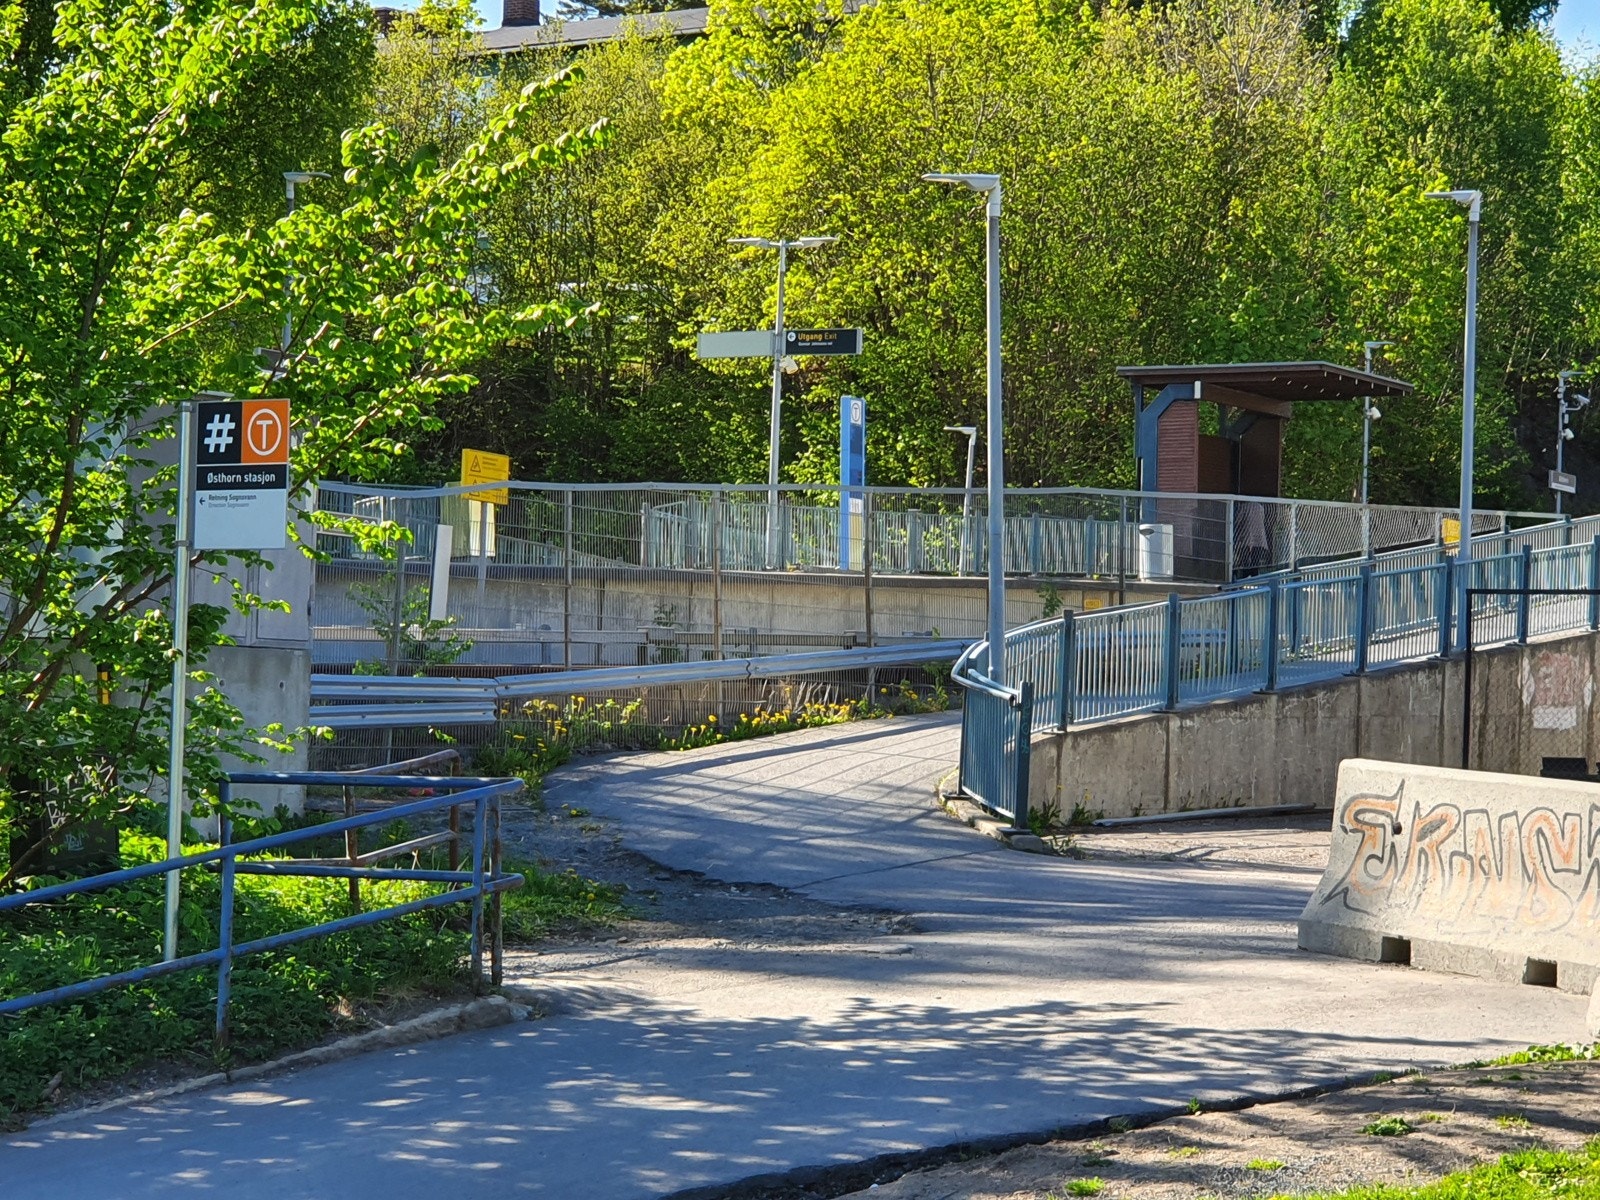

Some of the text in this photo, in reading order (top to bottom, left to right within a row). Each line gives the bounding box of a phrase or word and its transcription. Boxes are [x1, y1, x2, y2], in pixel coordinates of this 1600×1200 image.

[797, 332, 837, 342] Utgang Exit
[207, 471, 276, 485] Østhorn stasjon
